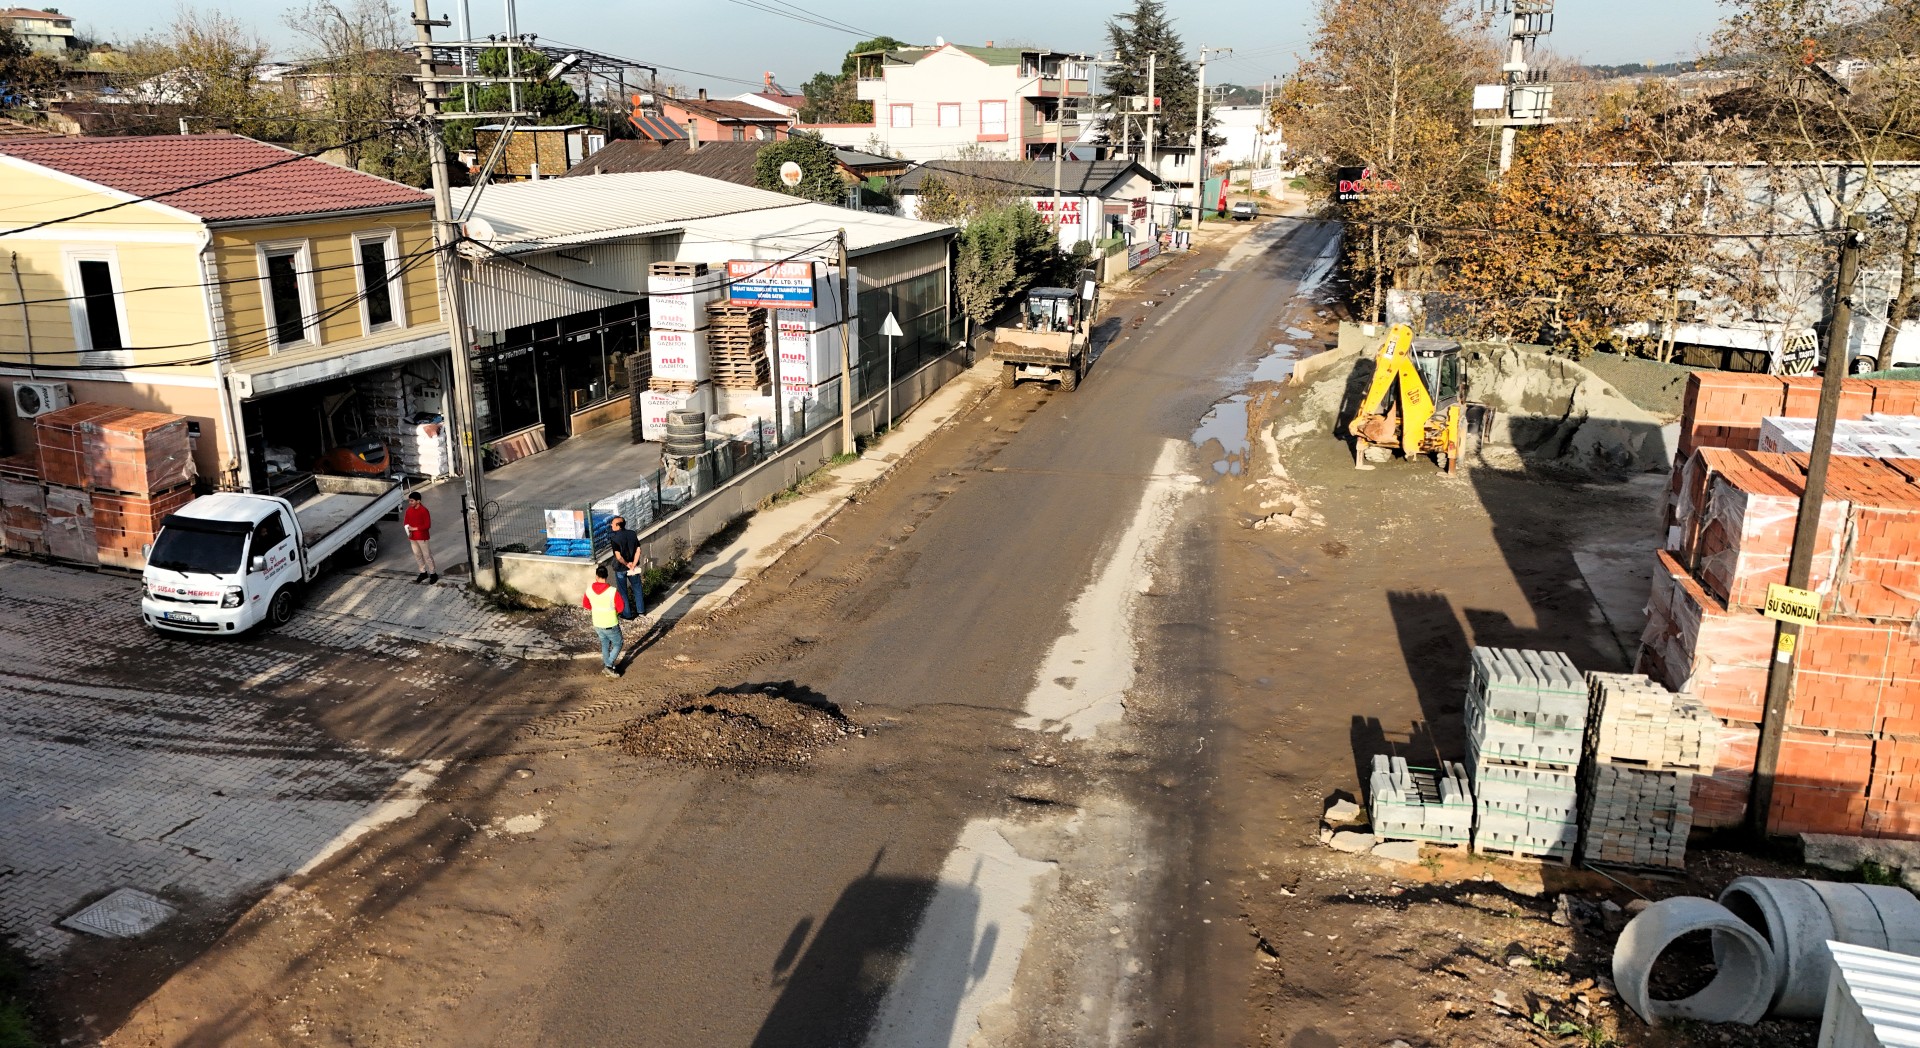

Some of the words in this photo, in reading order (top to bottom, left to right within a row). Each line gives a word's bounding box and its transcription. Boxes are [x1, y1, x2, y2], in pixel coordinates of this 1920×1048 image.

[1037, 200, 1080, 211] EMAK
[660, 314, 683, 322] nuh
[780, 323, 803, 331] nuh
[1407, 388, 1420, 404] JCB
[157, 585, 176, 593] SUŞAR
[187, 589, 220, 597] MERMER
[1767, 599, 1780, 612] SU
[1780, 602, 1817, 620] SONDAJI
